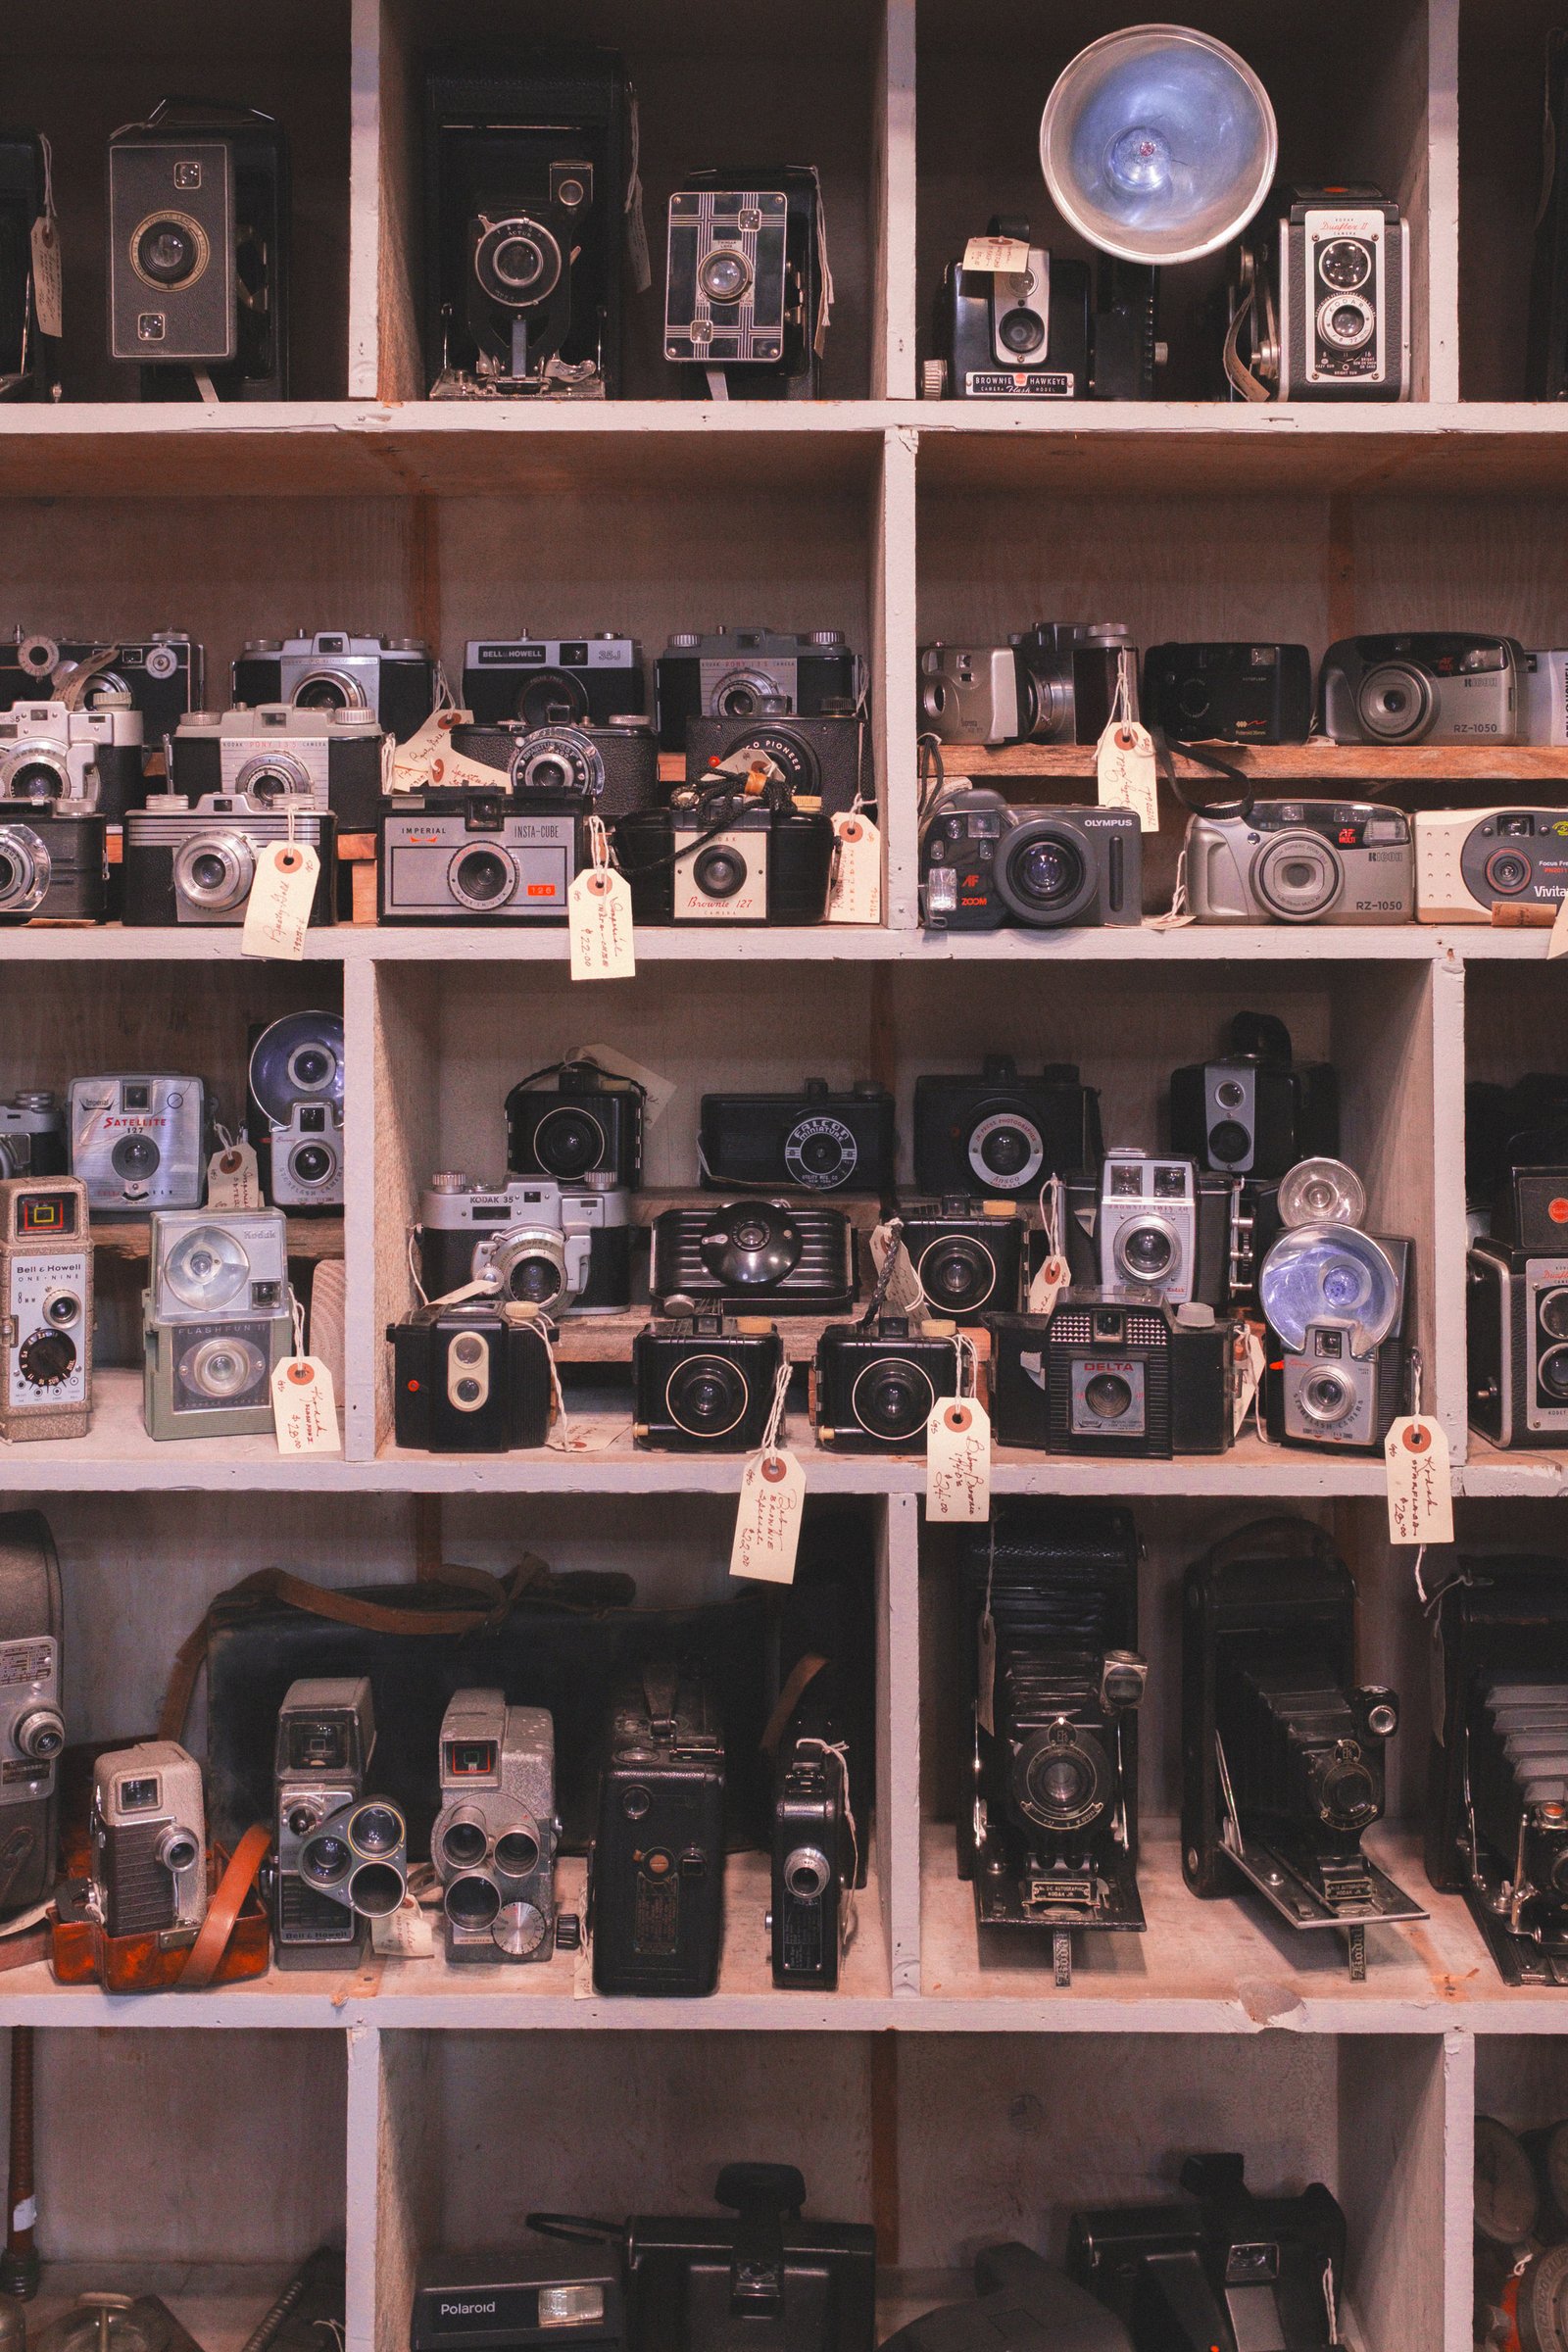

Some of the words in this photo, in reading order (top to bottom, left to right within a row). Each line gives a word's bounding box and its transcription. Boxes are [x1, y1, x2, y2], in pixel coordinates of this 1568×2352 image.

[975, 376, 1012, 385] BROWNIE
[1029, 377, 1065, 386] HAWKEYE
[1453, 723, 1498, 733] RZ-1050
[765, 739, 802, 772] PIONEER
[514, 825, 560, 839] INSTA-CUBE
[1368, 852, 1403, 862] RICOH
[961, 874, 980, 888] AF
[530, 886, 552, 895] 126
[1534, 885, 1568, 898] Vivita
[687, 896, 730, 908] Brownie
[736, 899, 753, 908] 127
[960, 898, 988, 906] ZOOM
[1355, 901, 1402, 910] RZ-1050
[103, 1117, 167, 1129] SATELLITE
[794, 1120, 850, 1140] FALCON
[799, 1126, 844, 1143] MINIATURE
[243, 1230, 276, 1240] Kodak
[17, 1265, 36, 1274] Bell
[47, 1263, 81, 1273] Howell
[177, 1325, 252, 1336] FLASHFUN
[1084, 1362, 1134, 1372] DELTA
[441, 2301, 496, 2315] Polaroid
